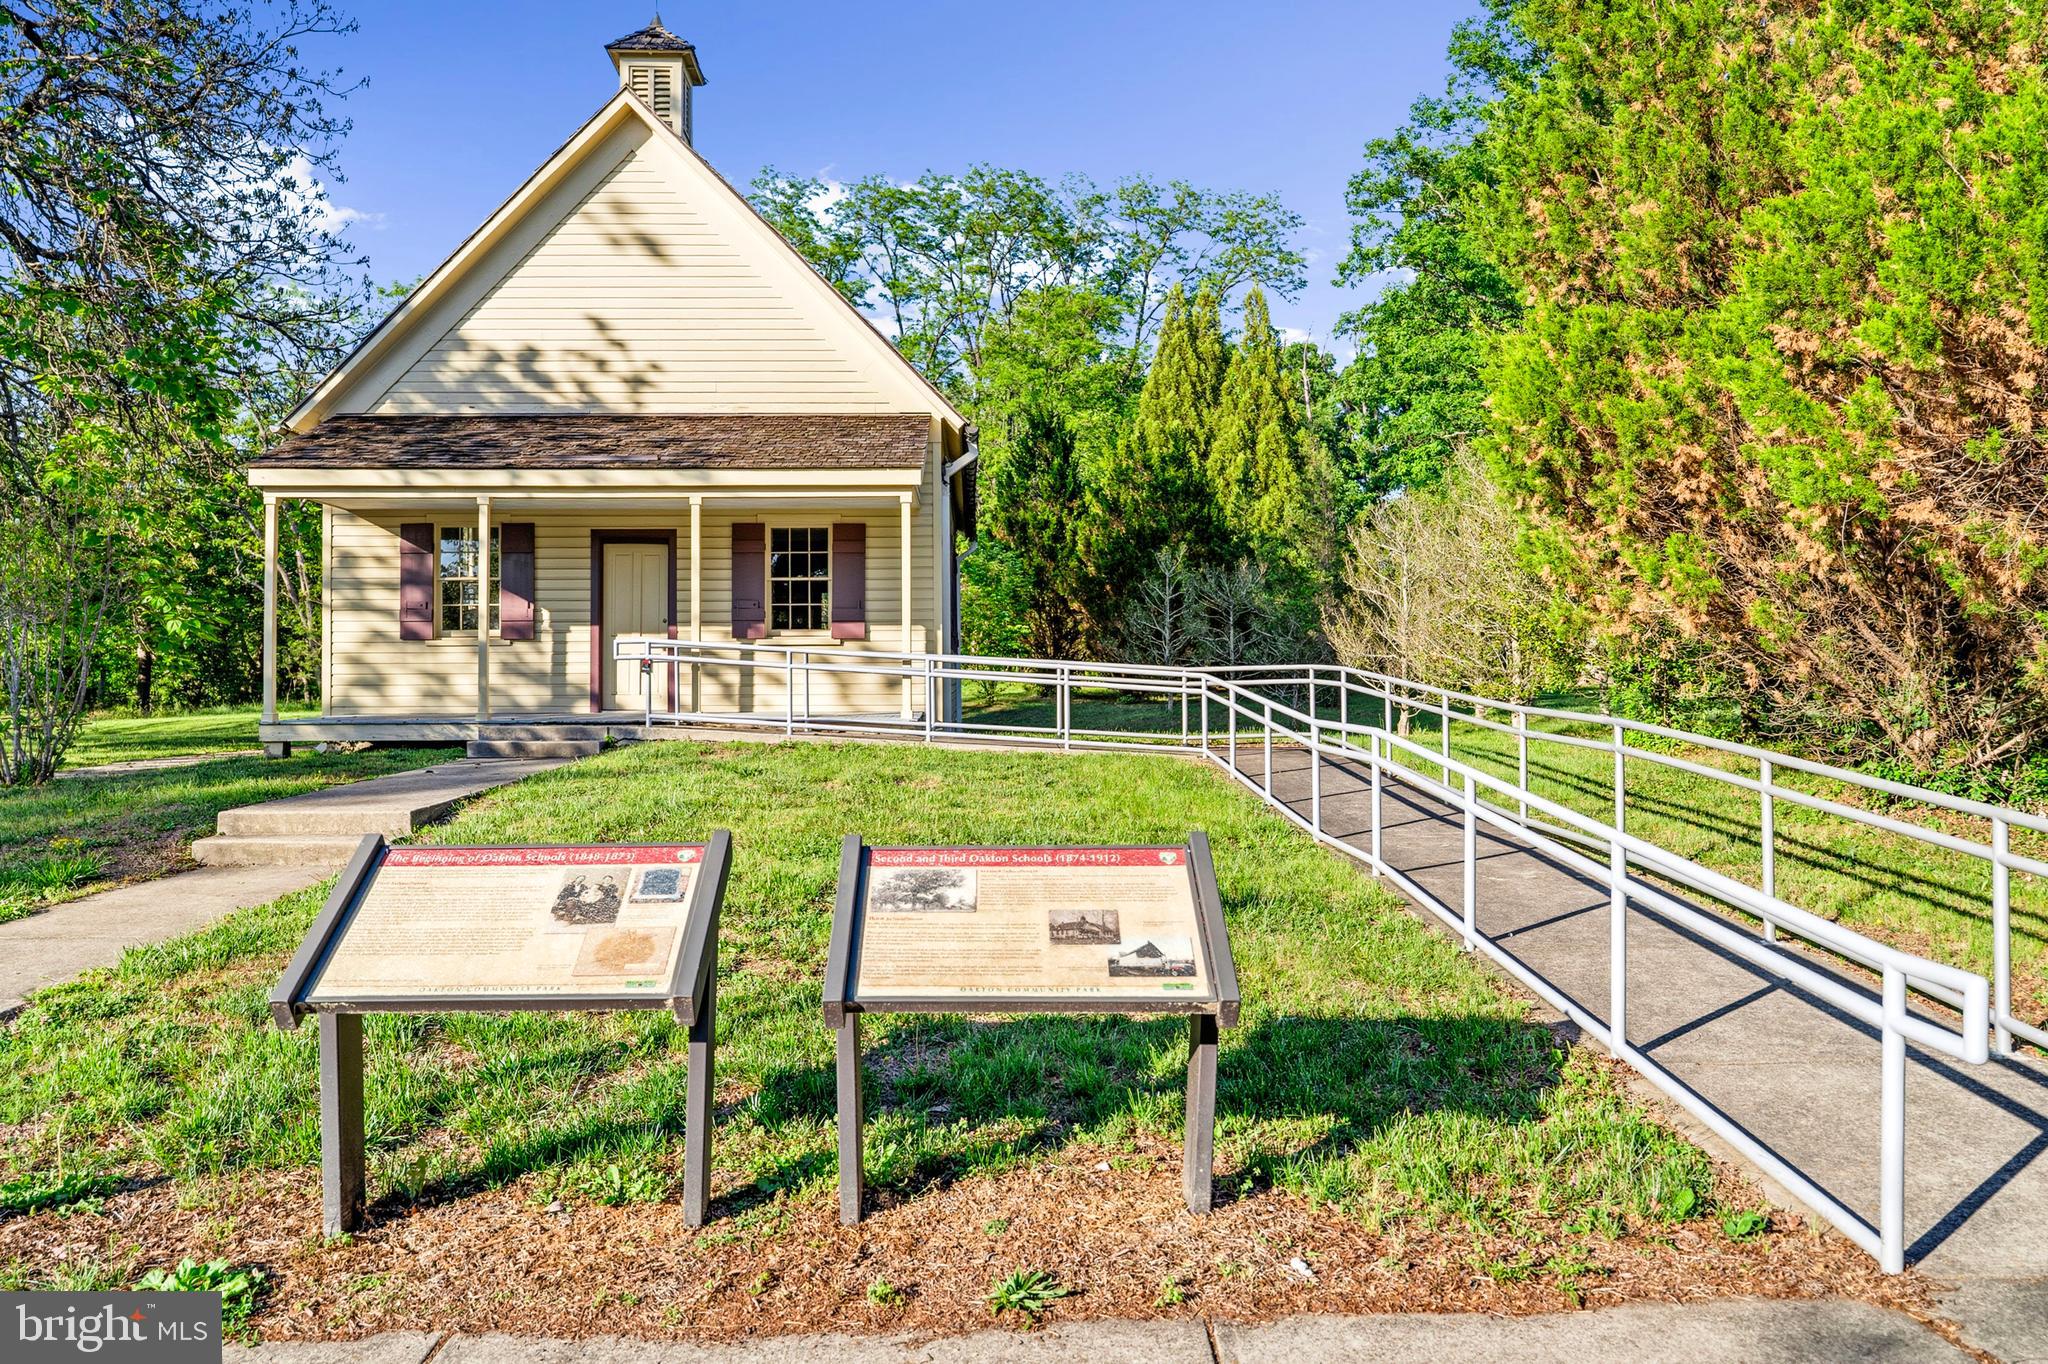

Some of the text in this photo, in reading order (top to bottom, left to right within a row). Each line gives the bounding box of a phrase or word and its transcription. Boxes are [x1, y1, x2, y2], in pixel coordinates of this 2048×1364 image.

[389, 851, 635, 866] The Beginning of Oakton Schools (1848-1873)
[875, 853, 1121, 864] Second and Third Oakton Schools (1874-1912)
